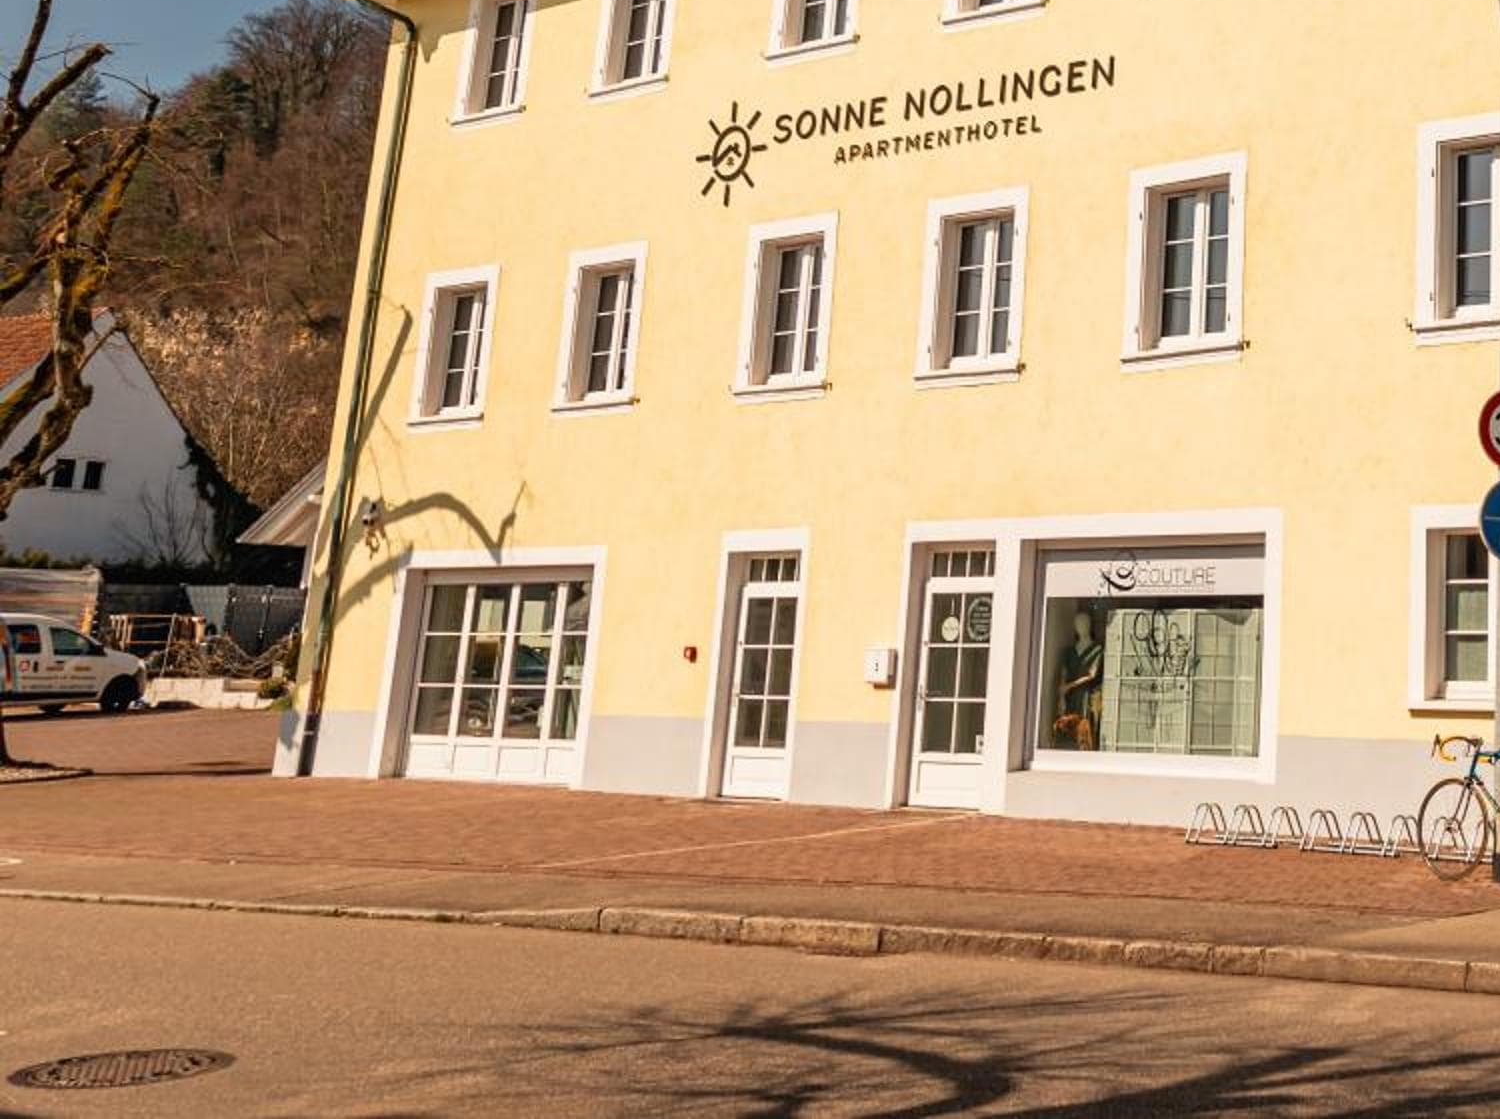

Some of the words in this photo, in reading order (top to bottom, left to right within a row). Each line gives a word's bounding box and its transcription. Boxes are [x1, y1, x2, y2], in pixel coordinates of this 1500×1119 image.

[773, 96, 888, 143] SONNE
[903, 55, 1116, 121] NOLLINGEN
[834, 114, 1042, 165] APARTMENTHOTEL
